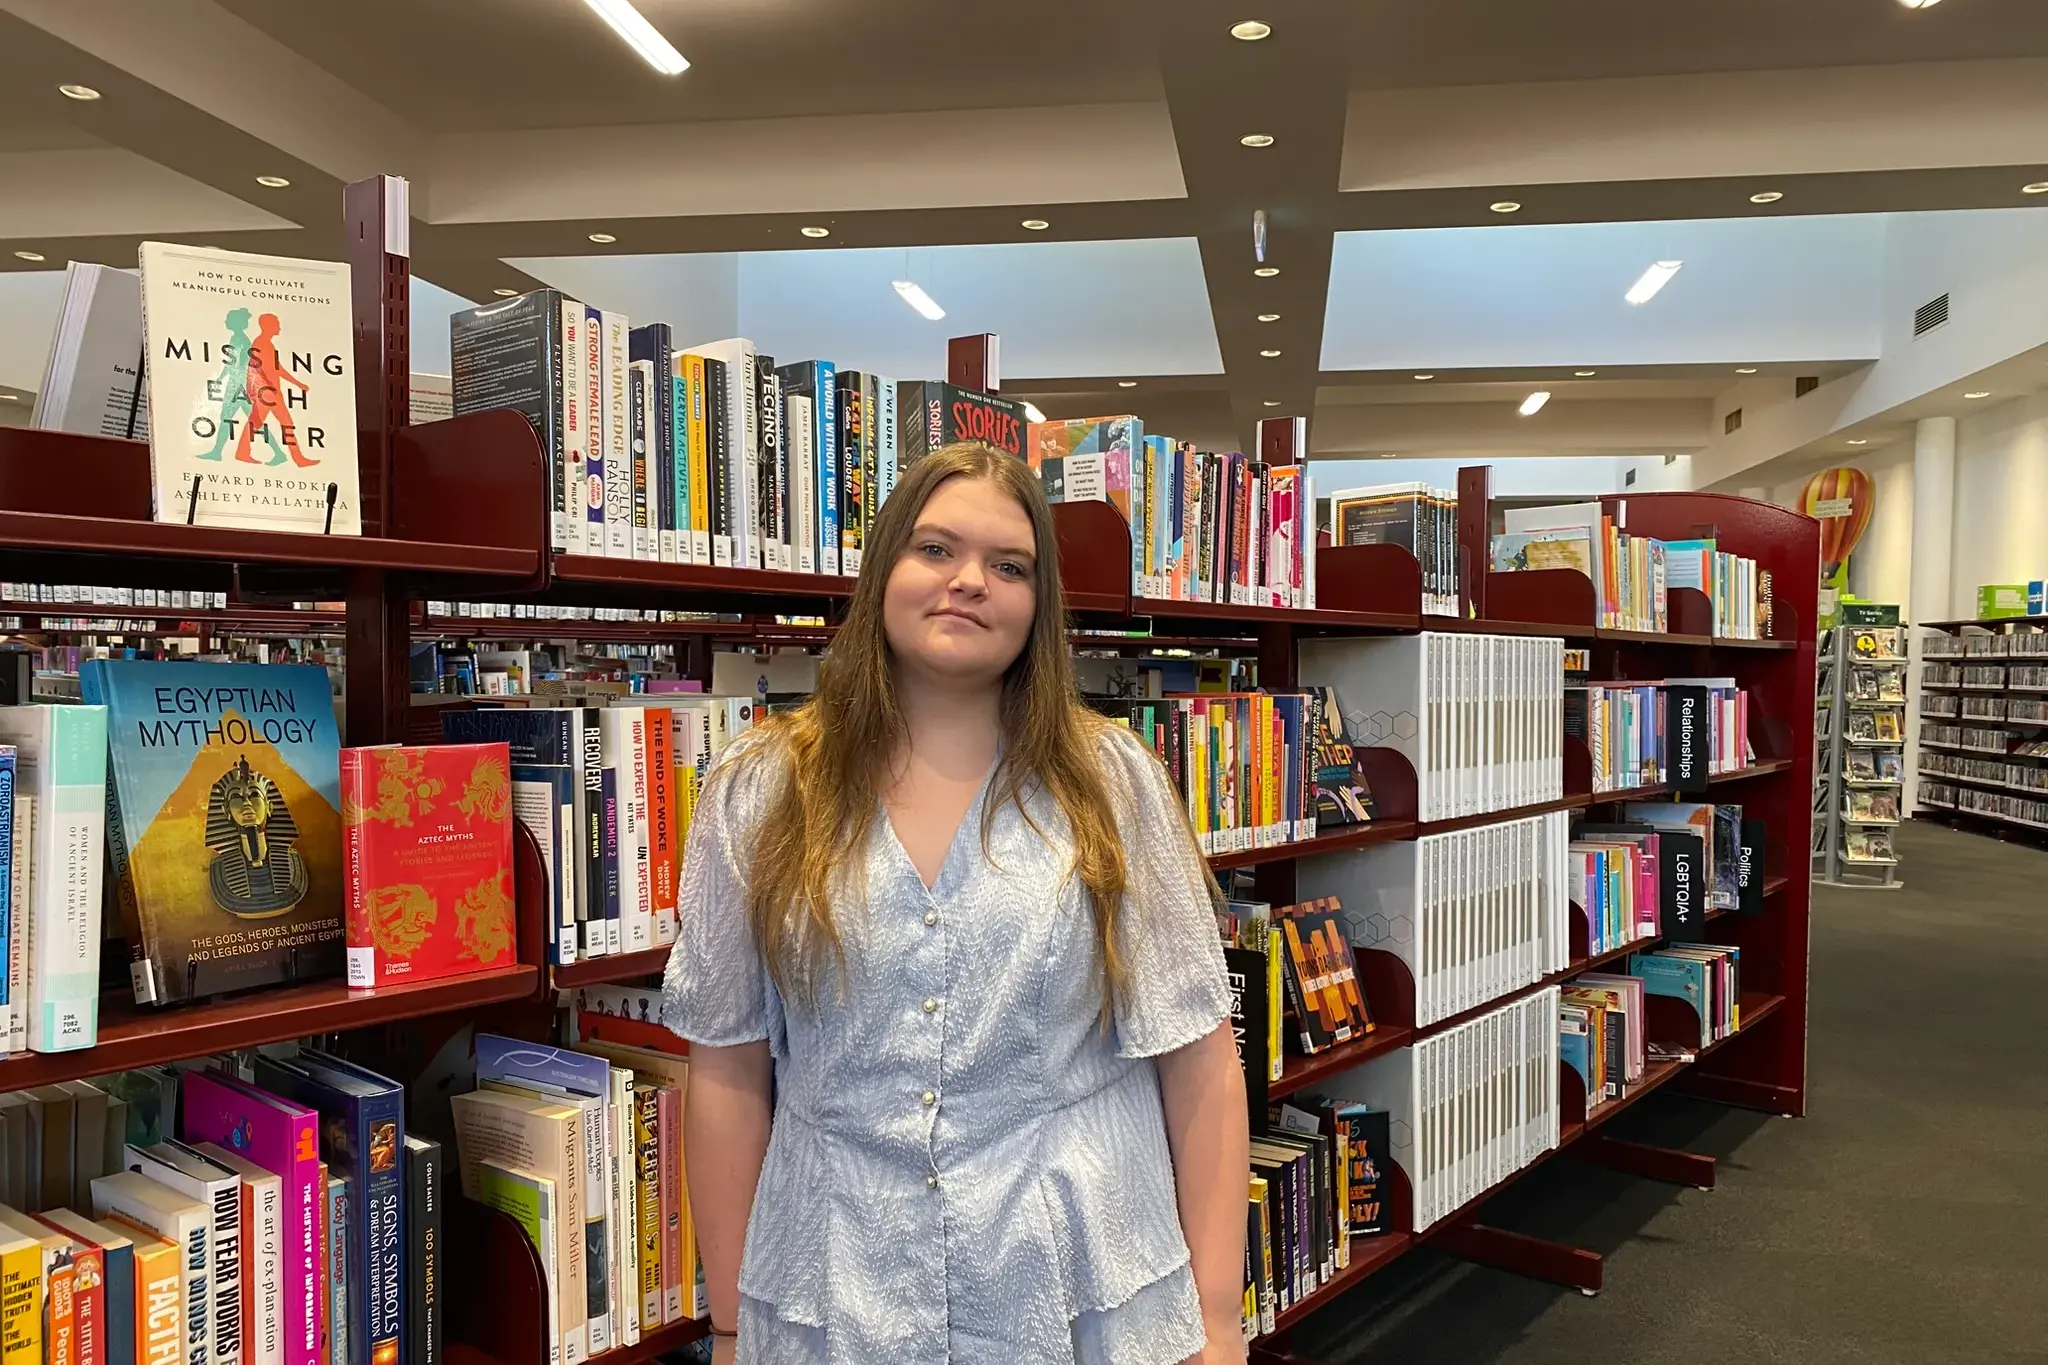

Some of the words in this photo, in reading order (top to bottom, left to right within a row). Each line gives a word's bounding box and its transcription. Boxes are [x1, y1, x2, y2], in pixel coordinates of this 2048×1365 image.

[172, 281, 247, 297] MEANINGFUL
[251, 290, 331, 305] CONNECTIONS
[198, 270, 224, 280] HOW
[228, 273, 243, 283] TO
[247, 276, 306, 289] CULTIVATE
[568, 312, 575, 324] SO
[568, 326, 576, 342] YOU
[165, 337, 343, 376] MISSING
[568, 344, 576, 366] WANT
[588, 323, 598, 371] STRONG
[113, 365, 124, 373] for
[125, 367, 136, 376] the
[568, 368, 576, 378] TO
[568, 381, 576, 391] BE
[612, 346, 623, 411] LEADING
[824, 370, 831, 378] A
[207, 380, 308, 410] EACH
[589, 372, 600, 418] FEMALE
[664, 394, 668, 404] ON
[677, 382, 687, 438] EVERYDAY
[763, 373, 775, 447] TECHNO
[824, 383, 834, 420] WORLD
[967, 392, 982, 402] NUMBER
[191, 416, 325, 448] OTHER
[568, 399, 577, 432] LEADER
[590, 420, 599, 457] LEAD
[613, 422, 624, 455] EDGE
[825, 423, 835, 475] WITHOUT
[678, 439, 688, 499] ACTIVISM
[619, 470, 629, 524] HOLLY
[826, 477, 836, 511] WORK
[154, 687, 296, 714] EGYPTIAN
[137, 719, 317, 748] MYTHOLOGY
[632, 720, 641, 739] HOW
[653, 718, 663, 747] THE
[1680, 698, 1694, 779] Relationships
[584, 726, 601, 793] RECOVERY
[633, 741, 642, 754] TO
[634, 755, 643, 795] EXPECT
[654, 751, 664, 785] END
[636, 797, 645, 821] THE
[656, 787, 665, 804] OF
[14, 814, 22, 833] THE
[70, 826, 77, 840] OF
[418, 835, 443, 844] AZTEC
[446, 833, 474, 842] MYTHS
[437, 824, 454, 832] THE
[657, 806, 667, 852] WOKE
[80, 826, 88, 859] WOMEN
[13, 836, 22, 883] BEAUTY
[69, 842, 77, 889] ANCIENT
[80, 862, 88, 885] AND
[1739, 846, 1752, 887] Politics
[13, 885, 20, 901] OF
[352, 878, 360, 909] MYTHS
[662, 860, 670, 900] ANDREW
[1675, 854, 1689, 923] LGBTQIA+
[12, 903, 20, 938] WHAT
[67, 892, 75, 922] ISRAEL
[79, 912, 87, 959] RELIGION
[187, 948, 210, 962] AND
[213, 941, 260, 958] LEGENDS
[261, 939, 274, 950] OF
[277, 932, 316, 948] ANCIENT
[319, 929, 346, 943] EGYPT
[191, 936, 211, 949] THE
[213, 931, 246, 946] GODS,
[248, 926, 289, 944] HEROES,
[290, 917, 339, 935] MONSTERS
[11, 941, 20, 988] REMAINS
[385, 962, 409, 970] Thames
[385, 966, 412, 976] &Hudson
[593, 1107, 601, 1145] Human
[644, 1098, 657, 1130] THE
[566, 1120, 579, 1188] Migrants
[595, 1147, 603, 1182] Peoples
[303, 1183, 311, 1204] THE
[370, 1200, 378, 1208] &
[644, 1136, 660, 1242] PERENNIALS
[214, 1186, 238, 1232] HOW
[383, 1195, 397, 1251] SIGNS,
[568, 1193, 576, 1226] Sam
[303, 1207, 312, 1252] HISTORY
[371, 1211, 379, 1248] DREAM
[425, 1228, 433, 1250] 100
[188, 1226, 206, 1271] HOW
[215, 1235, 239, 1287] FEAR
[304, 1257, 312, 1269] OF
[568, 1230, 580, 1279] Miller
[4, 1272, 20, 1282] THE
[4, 1276, 40, 1295] ULTIMATE
[371, 1249, 381, 1338] INTERPRETATION
[4, 1291, 33, 1306] HIDDEN
[188, 1277, 208, 1344] MINDS
[384, 1254, 398, 1334] SYMBOLS
[4, 1304, 31, 1318] TRUTH
[5, 1320, 14, 1331] OF
[215, 1288, 240, 1357] WORKS
[305, 1273, 314, 1351] INFORMATION
[5, 1329, 20, 1341] THE
[5, 1338, 31, 1353] WORLD
